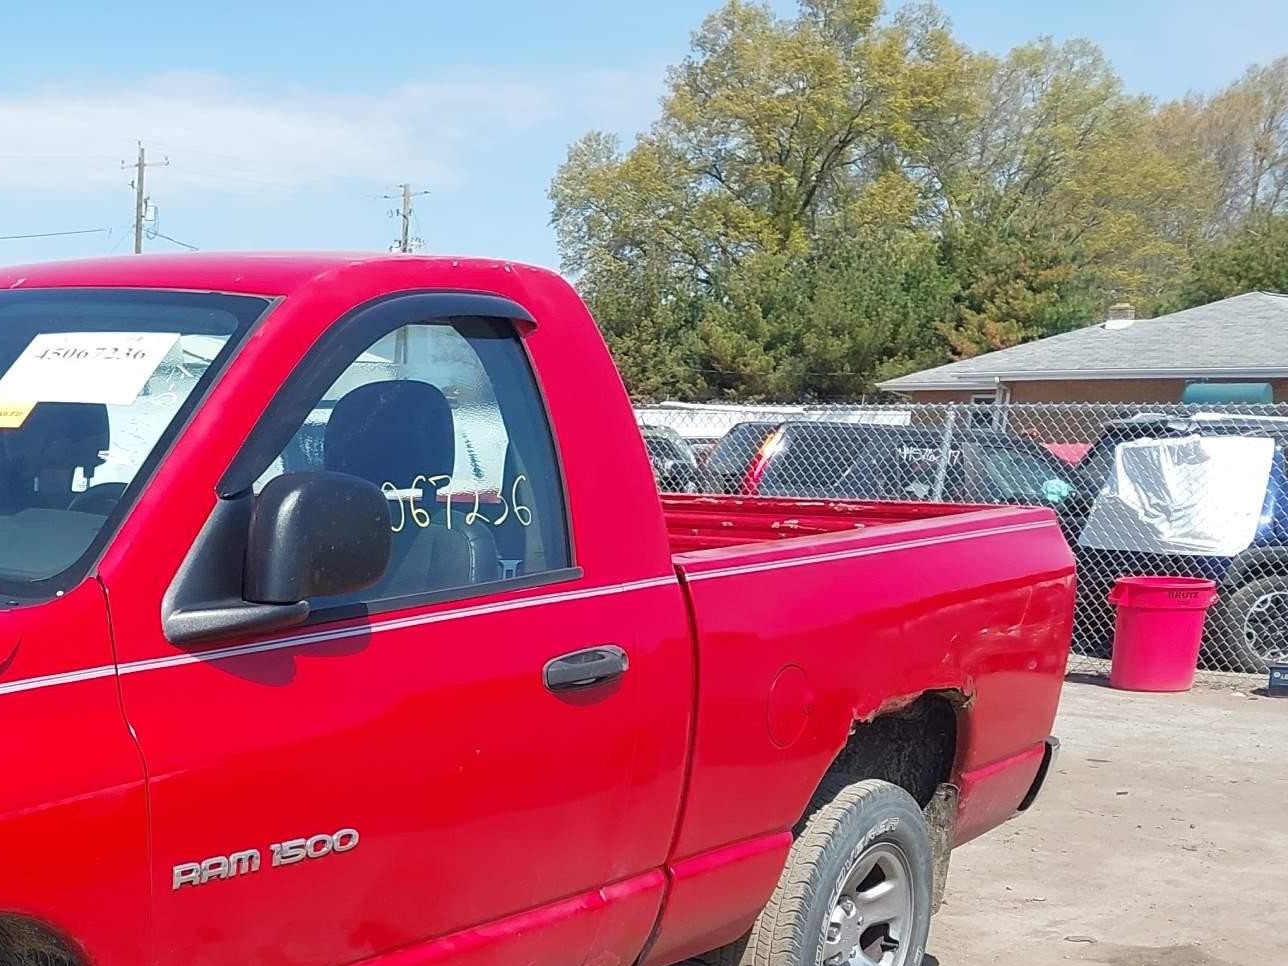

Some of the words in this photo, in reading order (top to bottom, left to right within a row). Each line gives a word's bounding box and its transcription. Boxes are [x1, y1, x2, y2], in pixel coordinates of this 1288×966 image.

[34, 347, 146, 361] 45067236
[171, 848, 261, 890] RAM
[269, 828, 360, 867] 1500
